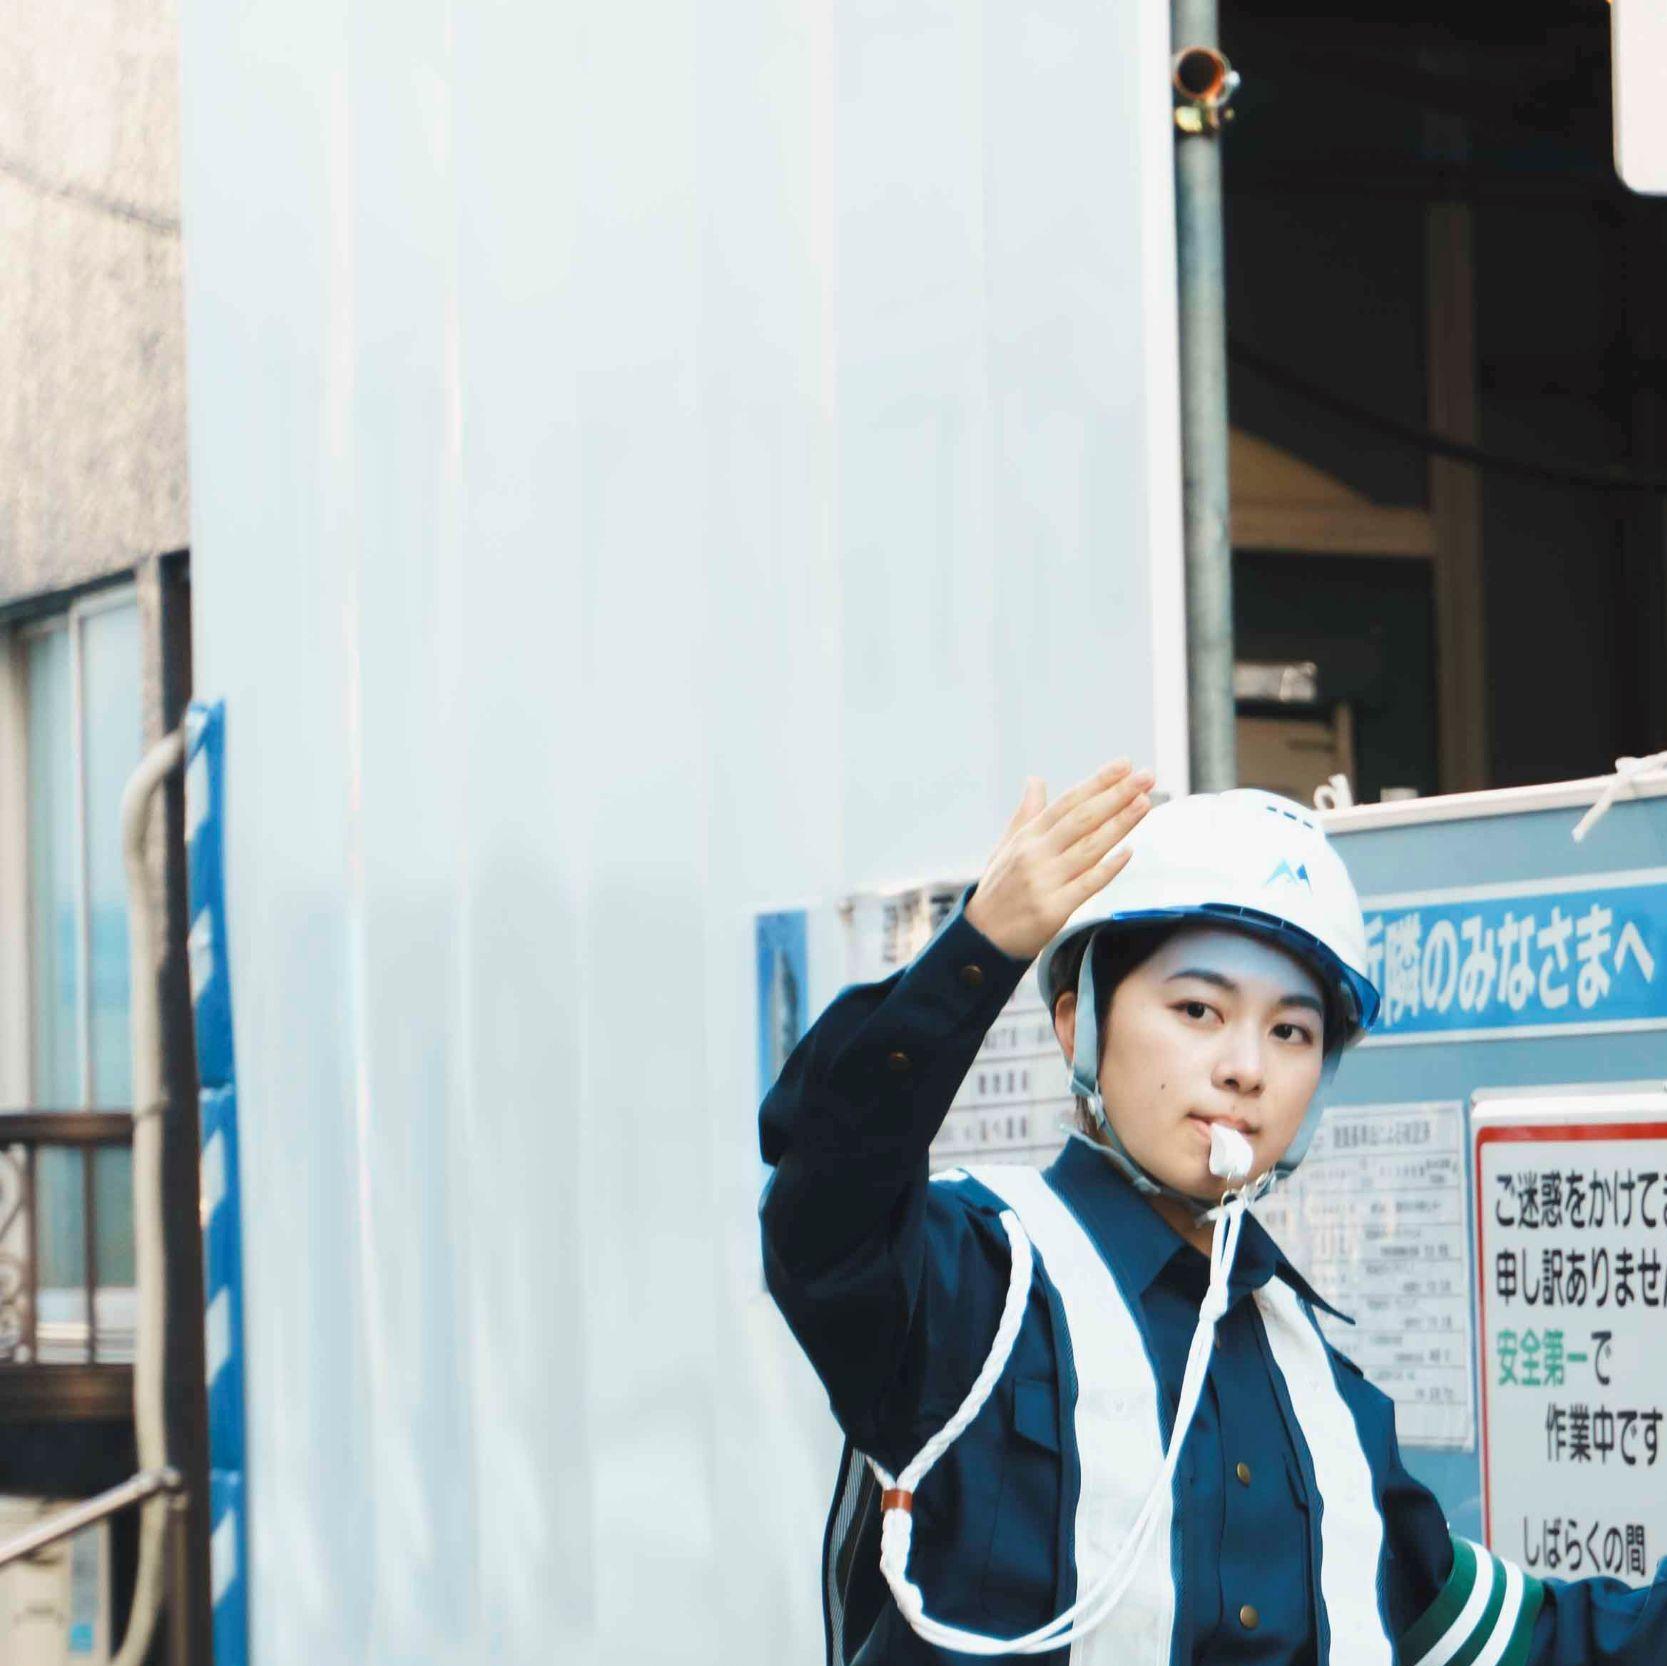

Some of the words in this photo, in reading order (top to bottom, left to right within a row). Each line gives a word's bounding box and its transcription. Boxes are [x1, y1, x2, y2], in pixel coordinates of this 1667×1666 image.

[1497, 1328, 1613, 1388] 安全第一で
[1546, 1406, 1665, 1467] 作業中です
[1523, 1516, 1647, 1576] しばらくの間
